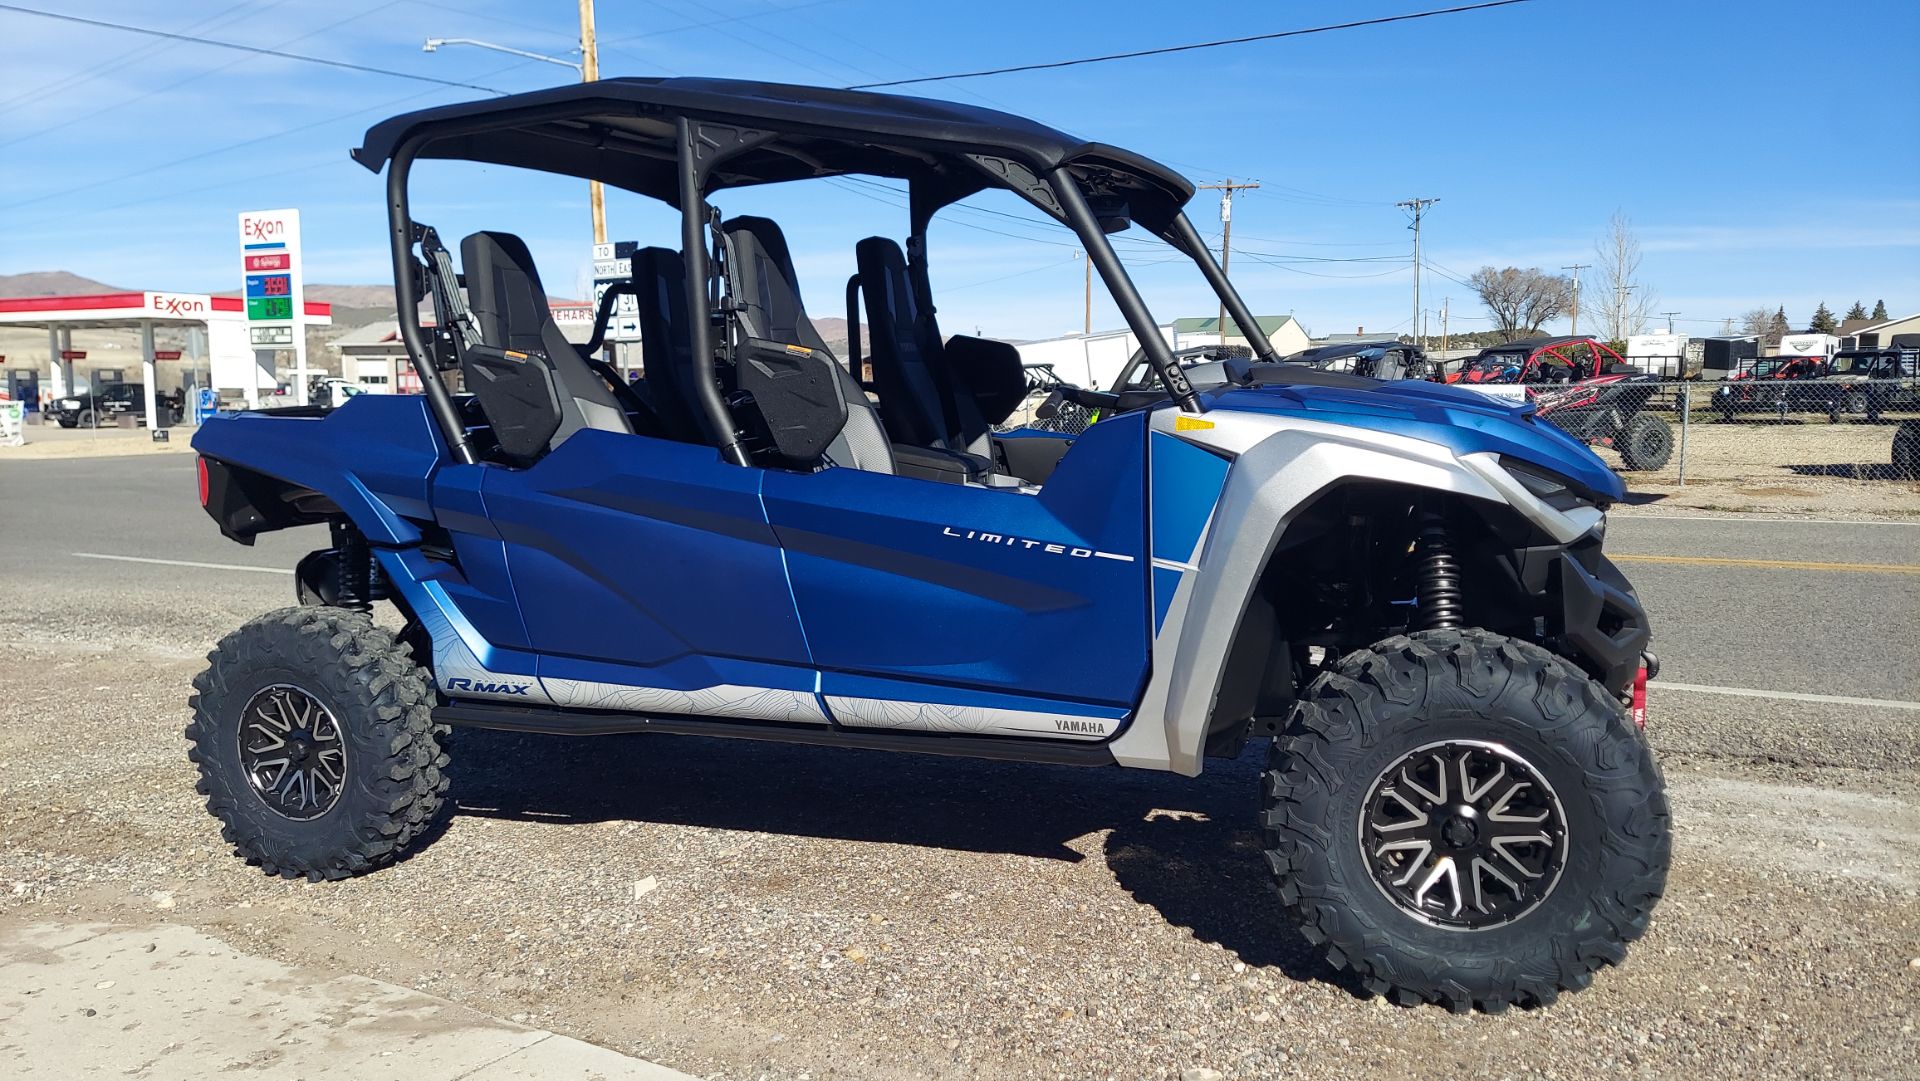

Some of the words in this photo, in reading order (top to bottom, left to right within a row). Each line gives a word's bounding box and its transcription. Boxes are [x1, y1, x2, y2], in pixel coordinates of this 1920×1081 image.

[244, 218, 284, 241] Exxon
[598, 247, 609, 256] TO
[594, 265, 615, 275] NORTH
[619, 262, 633, 274] EAS
[154, 296, 203, 316] Exxon
[942, 526, 1093, 559] LIMITED
[447, 678, 531, 695] RMAX
[1055, 719, 1106, 734] YAMAHA
